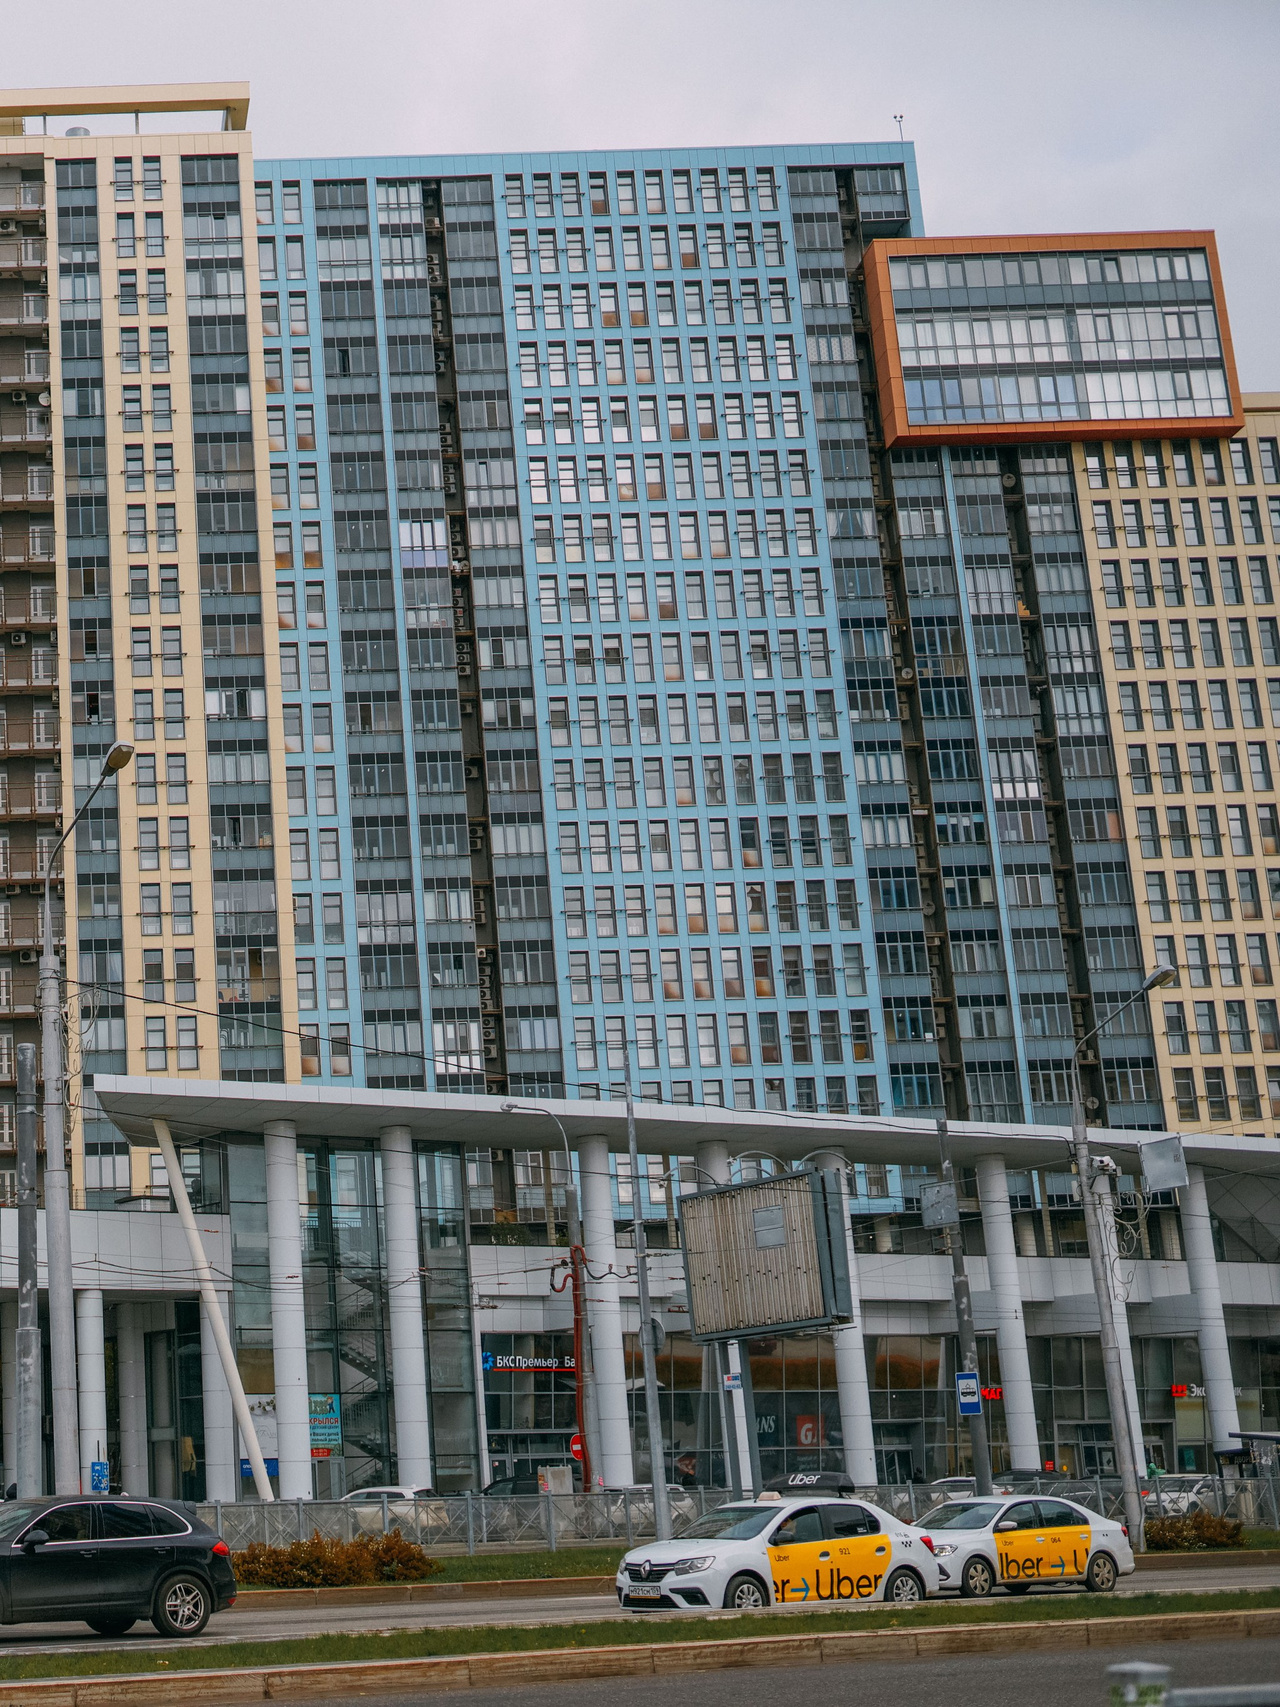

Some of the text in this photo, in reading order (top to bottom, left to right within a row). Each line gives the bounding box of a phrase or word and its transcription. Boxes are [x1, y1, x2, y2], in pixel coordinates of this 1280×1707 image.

[496, 1355, 515, 1367] БКС
[516, 1355, 559, 1369] Премьер
[309, 1417, 339, 1425] КРЫЛСЯ
[788, 1473, 821, 1485] Uber
[1001, 1539, 1015, 1547] Uber
[774, 1547, 851, 1562] Uber 921
[815, 1568, 883, 1601] Uber
